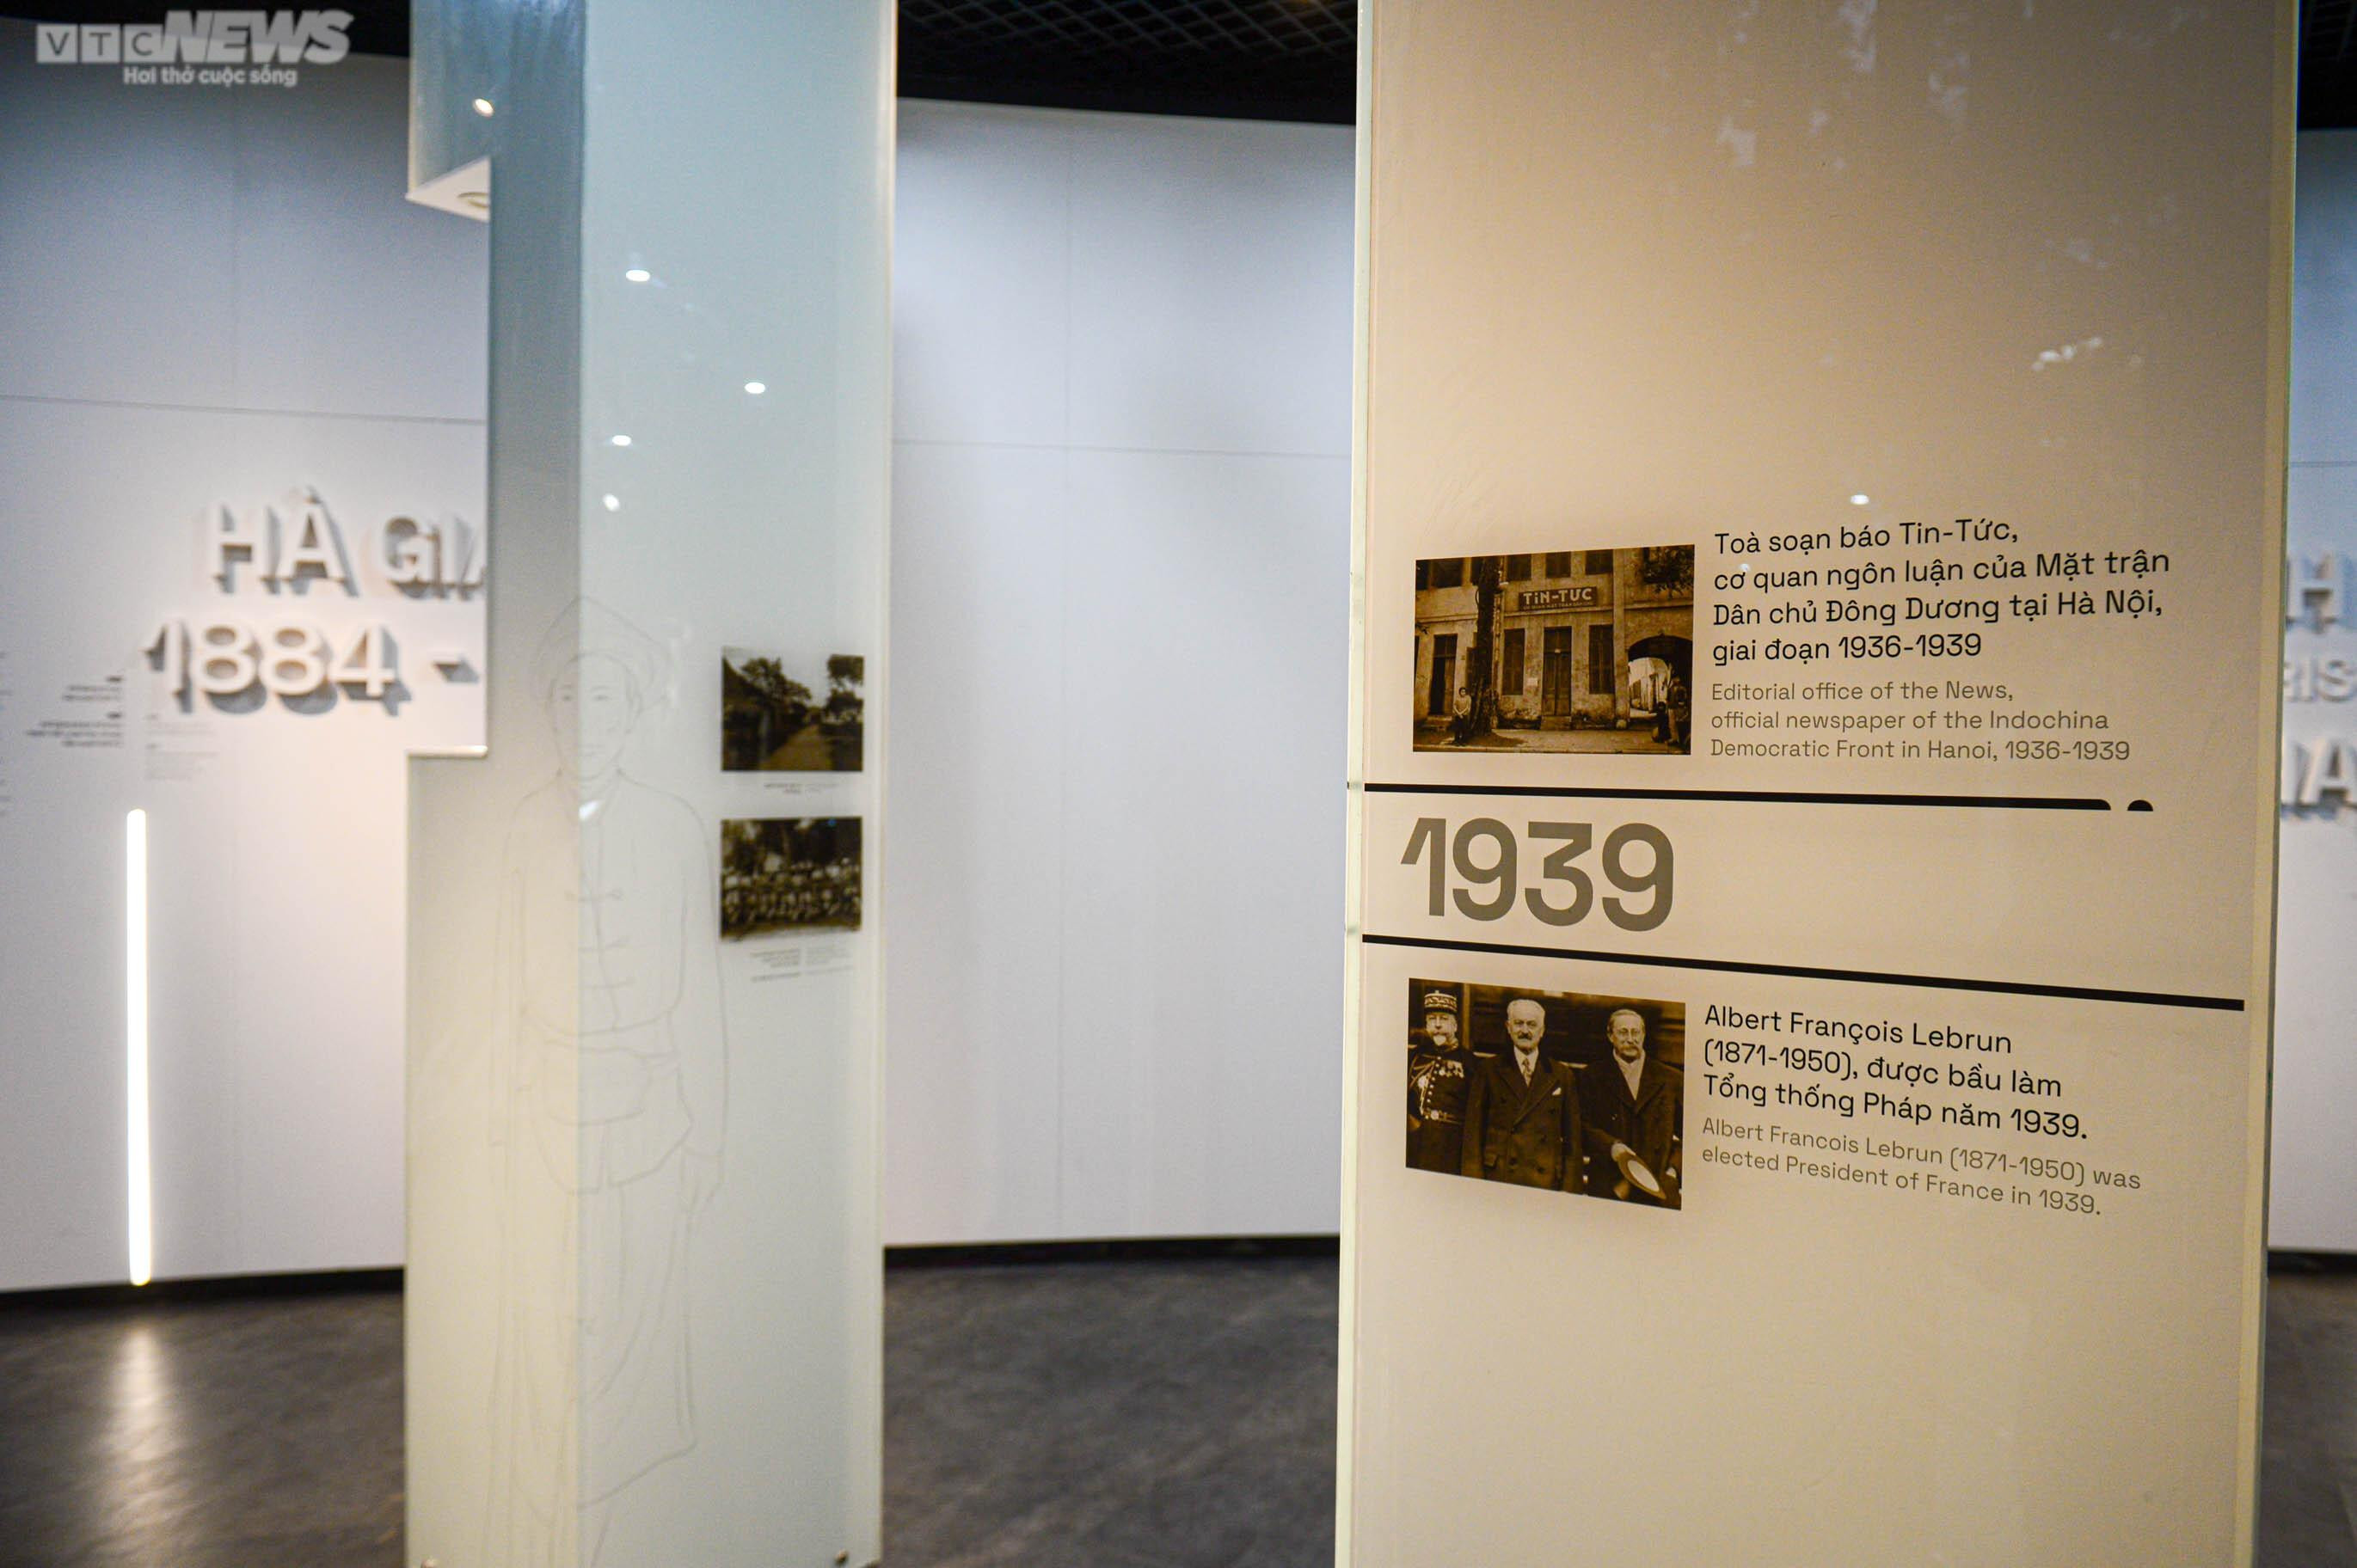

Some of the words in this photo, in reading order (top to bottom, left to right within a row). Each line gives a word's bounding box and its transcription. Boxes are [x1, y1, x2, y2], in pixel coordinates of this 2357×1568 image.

[1715, 531, 1761, 554] Toà
[1768, 533, 1830, 555] soạn
[1840, 525, 1890, 548] báo
[1899, 518, 2017, 545] Tin-Tức,
[1714, 572, 1746, 591] cơ
[1753, 570, 1817, 594] quan
[1827, 561, 1895, 591] ngôn
[1906, 559, 1963, 587] luận
[1973, 554, 2027, 579] của
[2036, 552, 2095, 581] Mặt
[2103, 549, 2169, 579] trận
[1713, 603, 1760, 626] Dân
[1769, 600, 1816, 624] chủ
[1826, 599, 1895, 626] Đông
[1906, 597, 1999, 623] Dương
[2009, 593, 2047, 622] tại
[2058, 591, 2096, 616] Hà
[2106, 589, 2162, 619] Nội,
[144, 619, 401, 701] 1884
[1713, 640, 1756, 666] giai
[1765, 638, 1829, 665] đoạn
[1838, 633, 1981, 658] 1936-1939
[1713, 683, 1795, 701] Editorial
[1802, 682, 1863, 700] office
[1870, 682, 1894, 700] of
[1900, 681, 1938, 699] the
[1946, 681, 2013, 701] News,
[1711, 711, 1778, 729] official
[1787, 715, 1906, 733] newspaper
[1912, 710, 1937, 729] of
[1943, 710, 1982, 729] the
[1990, 710, 2109, 729] Indochina
[1710, 738, 1829, 756] Democratic
[1837, 739, 1895, 757] Front
[1902, 740, 1919, 758] in
[1929, 739, 1998, 762] Hanoi,
[2005, 740, 2130, 760] 1936-1939
[1400, 817, 1674, 933] 1939
[1704, 1004, 1782, 1032] Albert
[1790, 1012, 1903, 1045] François
[1912, 1022, 2011, 1054] Lebrun
[1704, 1038, 1857, 1081] (1871-1950),
[1867, 1057, 1939, 1088] được
[1949, 1063, 2001, 1091] bầu
[2012, 1069, 2061, 1097] làm
[1703, 1072, 1766, 1107] Tổng
[1775, 1083, 1854, 1118] thống
[1864, 1092, 1932, 1126] Pháp
[1942, 1103, 2000, 1129] năm
[2010, 1108, 2087, 1139] 1939.
[1703, 1118, 1764, 1142] Albert
[1771, 1125, 1858, 1154] Francois
[1867, 1136, 1943, 1164] Lebrun
[1950, 1147, 2084, 1186] (1871-1950)
[2093, 1170, 2140, 1189] was
[1703, 1145, 1779, 1171] elected
[1787, 1155, 1888, 1186] President
[1896, 1173, 1919, 1190] of
[1927, 1173, 2004, 1202] France
[2012, 1185, 2030, 1205] in
[2038, 1190, 2101, 1216] 1939.
